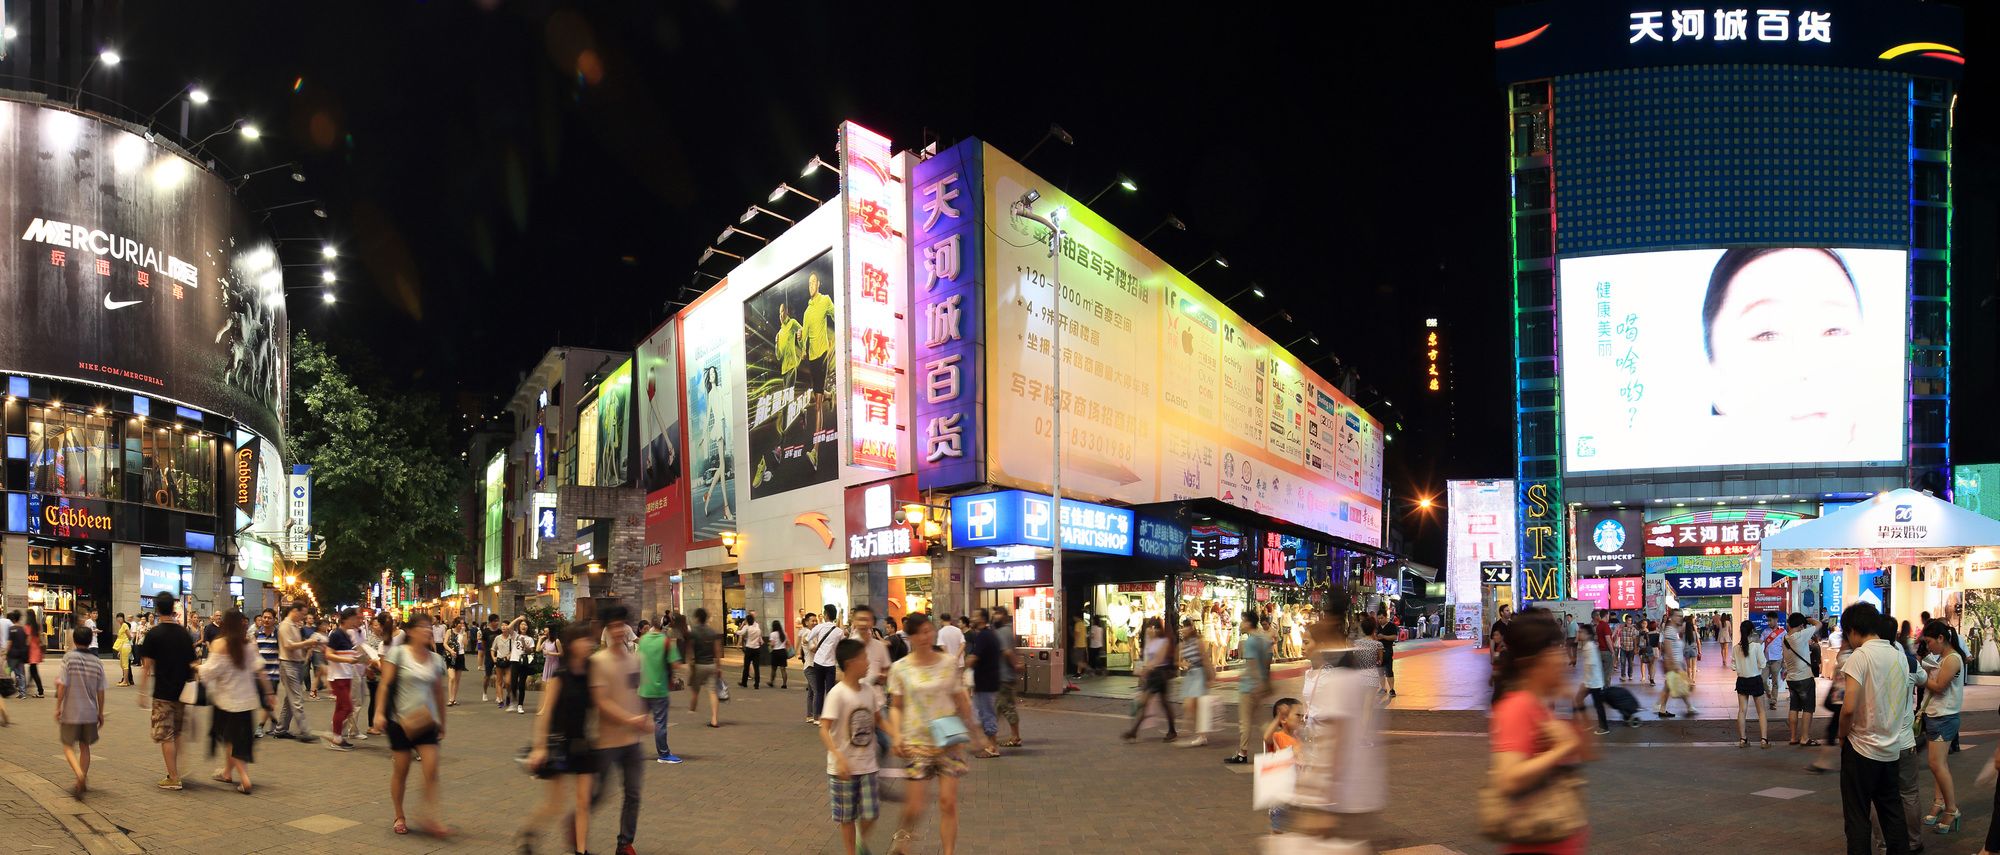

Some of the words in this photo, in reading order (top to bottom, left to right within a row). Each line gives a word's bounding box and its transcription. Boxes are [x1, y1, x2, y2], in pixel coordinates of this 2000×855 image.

[1629, 9, 1832, 43] 天河城百货
[22, 217, 169, 276] MERCURIAL
[1033, 226, 1149, 304] 铂宫写字楼招租
[859, 197, 893, 426] 安踏体育
[922, 172, 963, 462] 天河城百货
[1596, 281, 1612, 357] 健康美丽
[79, 361, 164, 386] NIKE.COM/MERCURIAL
[1026, 332, 1151, 398] 坐拥京路商圈最大停车场
[1165, 391, 1189, 409] CASIO
[238, 448, 253, 504] Cabbeen
[45, 505, 112, 530] Cabbeen
[850, 528, 911, 559] 东方眼镜
[1523, 483, 1559, 601] STM
[1587, 553, 1635, 561] STARBUCKS
[1679, 576, 1743, 589] 天河城百
[1830, 575, 1842, 613] Suning
